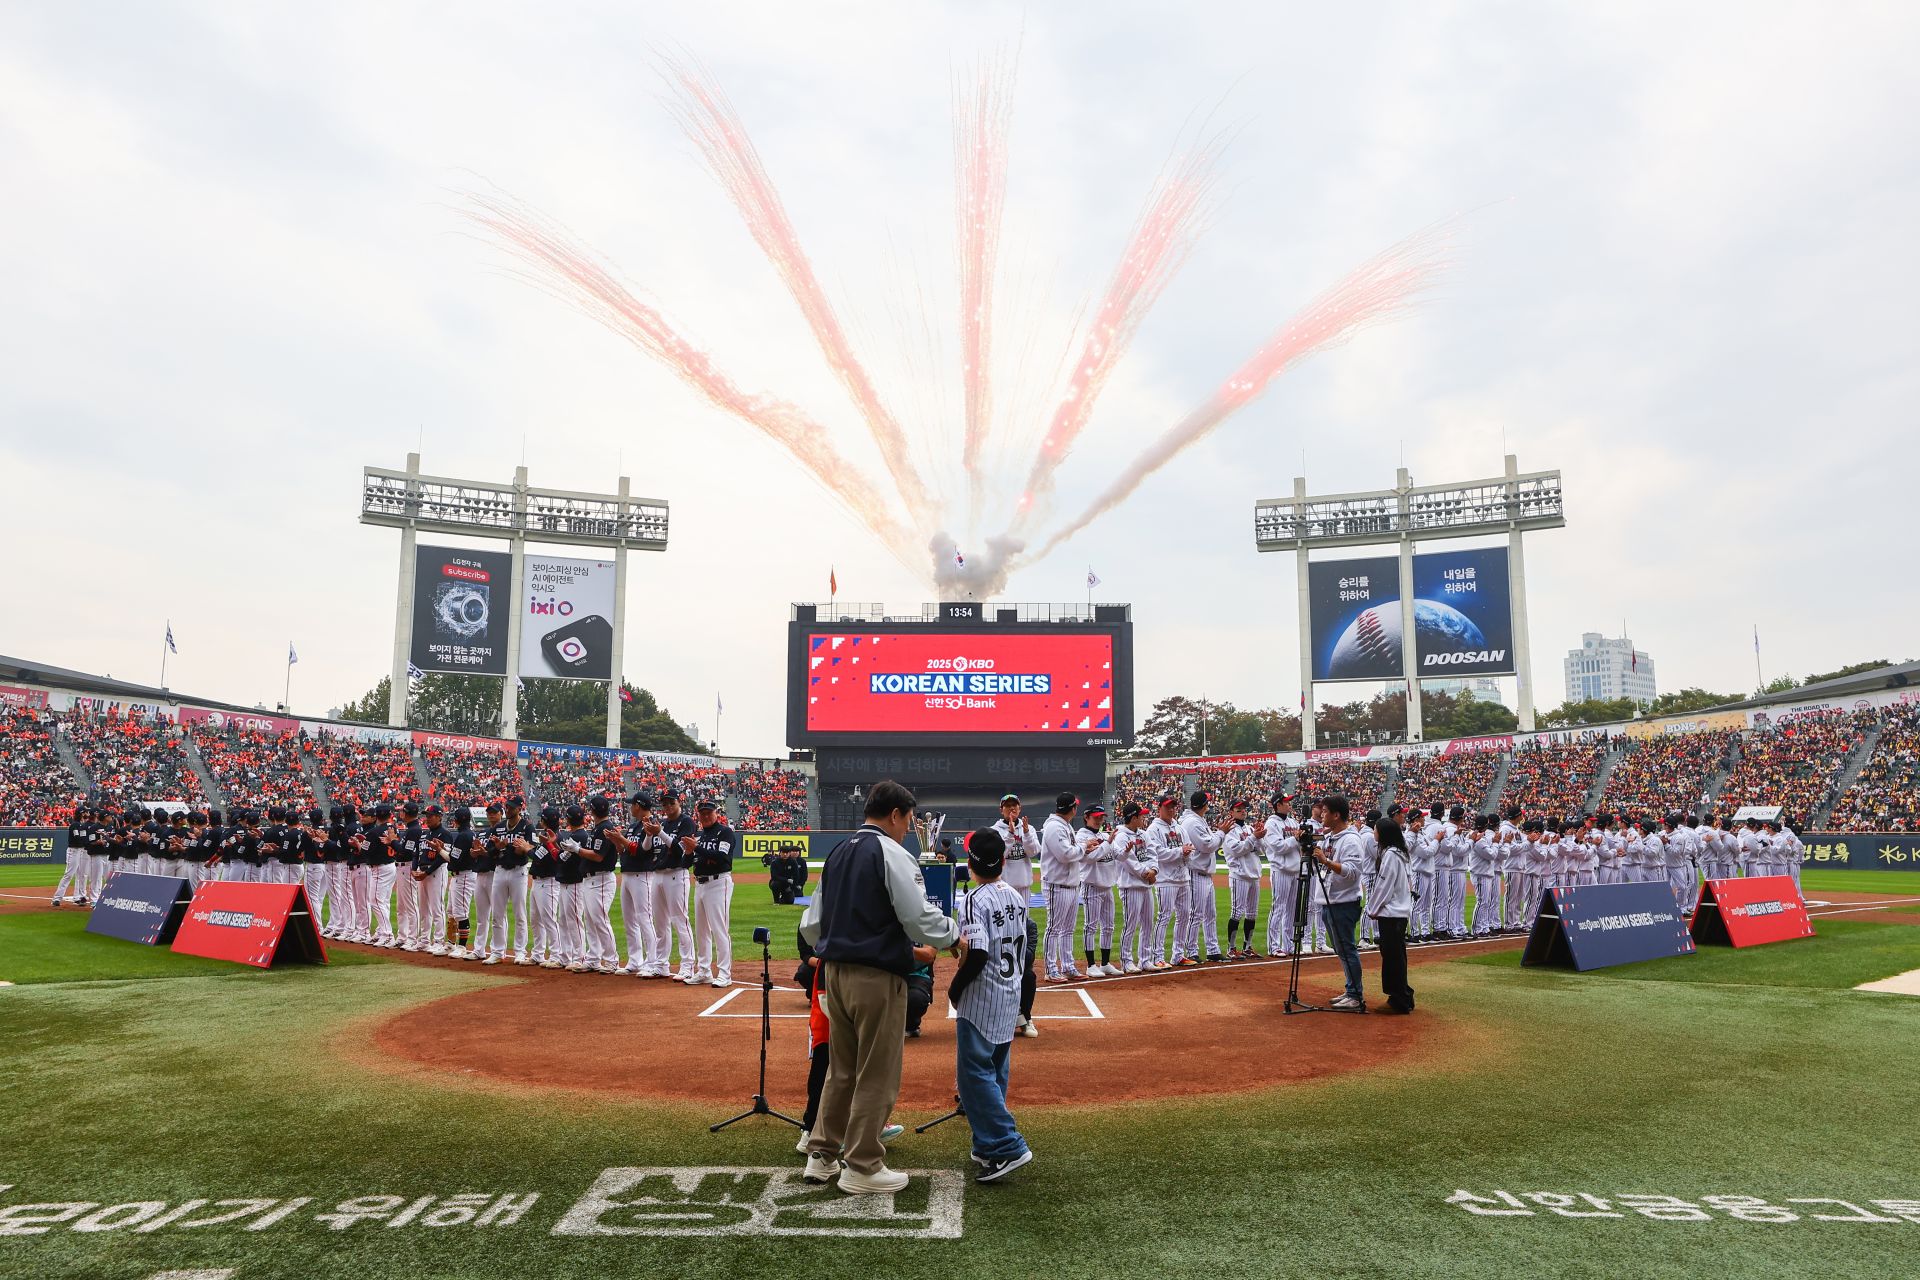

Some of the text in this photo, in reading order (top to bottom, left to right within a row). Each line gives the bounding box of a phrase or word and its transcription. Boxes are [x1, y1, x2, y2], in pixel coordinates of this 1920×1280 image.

[448, 569, 486, 580] subscribe
[532, 564, 589, 576] 보이스피싱 안심
[1444, 567, 1476, 580] 내일을
[532, 574, 575, 584] AI 에이전트
[1338, 575, 1369, 588] 승리를
[531, 583, 555, 593] 익시오
[1444, 581, 1476, 594] 위하여
[1339, 589, 1370, 602] 위하여
[950, 607, 972, 617] 13:54
[429, 644, 492, 656] 보이지 않는 곳까지
[437, 654, 483, 664] 가전 전문케어
[927, 659, 995, 669] 2025 KBO
[1424, 650, 1505, 666] DOOSAN
[871, 675, 1049, 693] KOREAN SERIES
[925, 697, 944, 708] 신한
[966, 698, 996, 708] Bank
[246, 718, 273, 731] CNS
[427, 735, 473, 752] redcap
[826, 757, 951, 773] 시작에 힘을 더하다
[986, 757, 1080, 774] 한화손해보험
[992, 904, 1026, 927] 홍창기
[1600, 914, 1631, 931] KOREAN
[1629, 912, 1654, 927] SERIES
[999, 935, 1025, 978] 51
[314, 1192, 541, 1231] 위해
